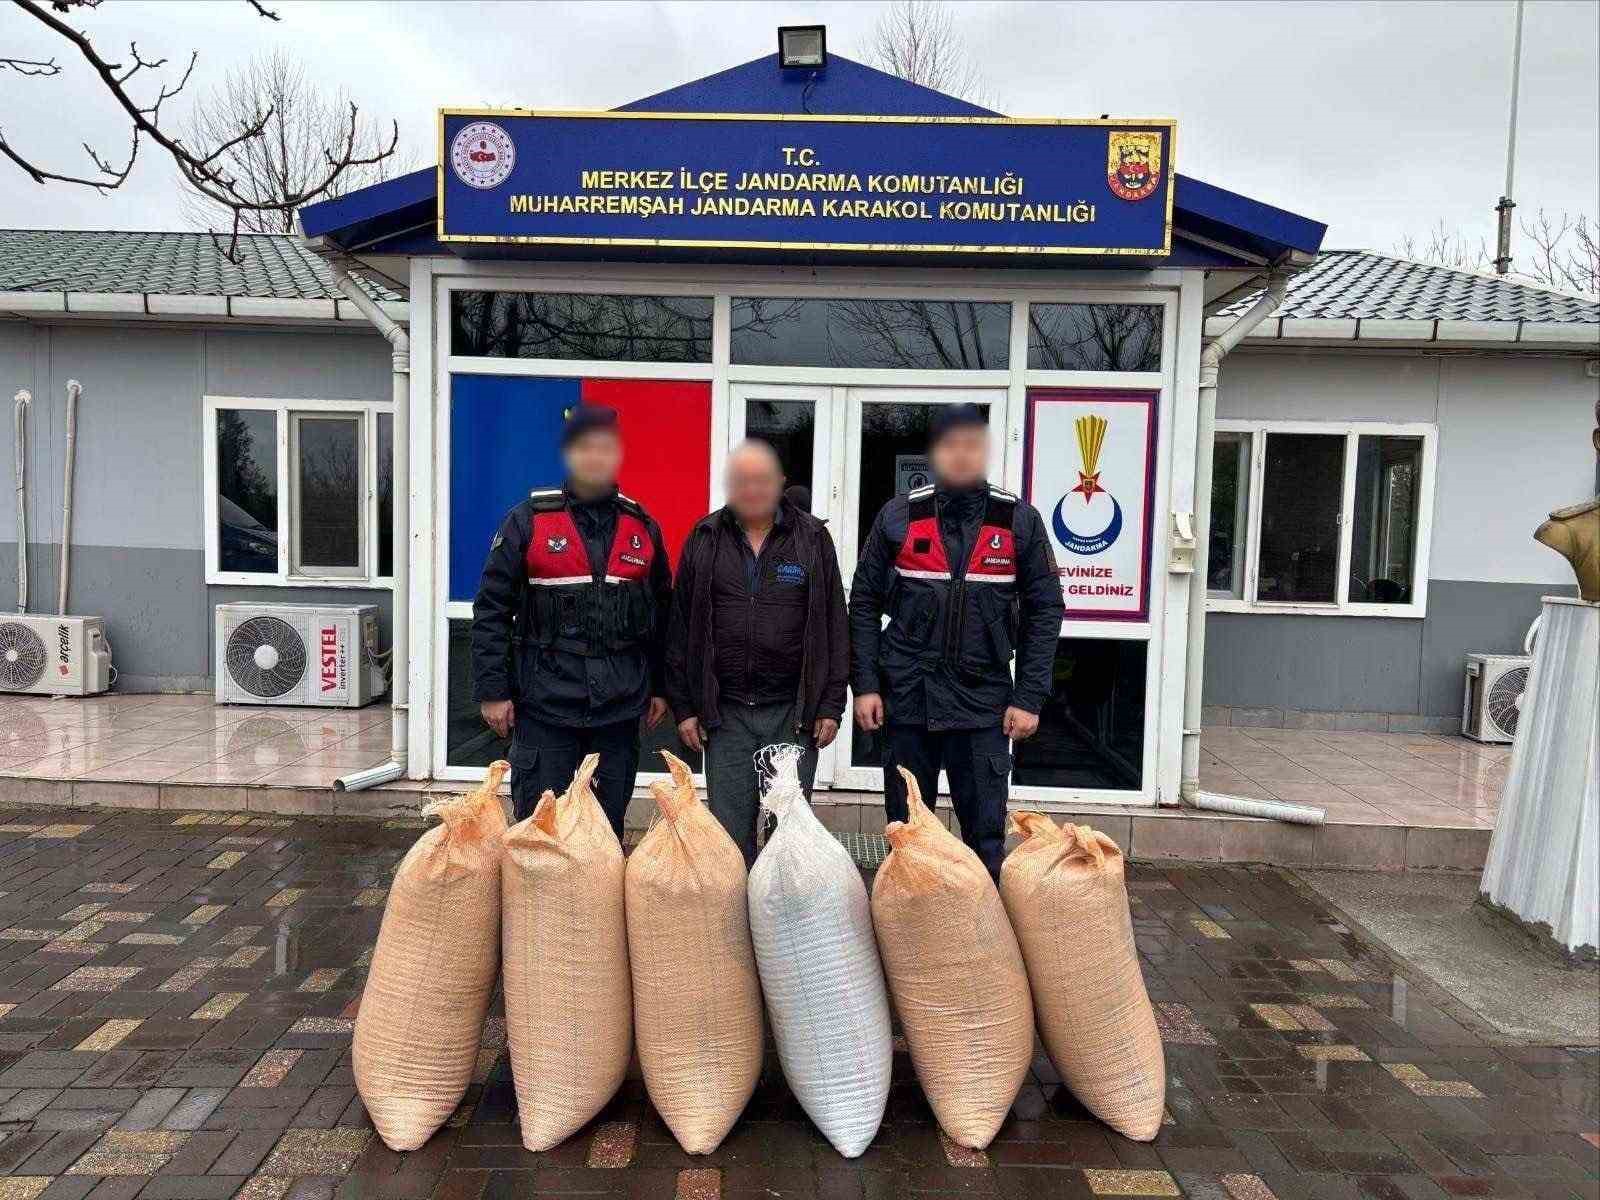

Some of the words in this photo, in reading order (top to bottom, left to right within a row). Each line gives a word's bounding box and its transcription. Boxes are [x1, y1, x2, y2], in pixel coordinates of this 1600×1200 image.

[781, 147, 819, 167] T.C.
[581, 170, 674, 189] MERKEZ
[680, 166, 728, 193] İLÇE
[735, 172, 862, 192] JANDARMA
[868, 172, 1023, 196] KOMUTANLIĞI
[510, 194, 684, 218] MUHARREMŞAH
[691, 197, 817, 217] JANDARMA
[822, 198, 933, 219] KARAKOL
[939, 199, 1096, 223] KOMUTANLIĞI
[1068, 584, 1134, 596] GELDİNİZ
[58, 623, 71, 664] arçelik
[321, 623, 336, 692] VESTEL
